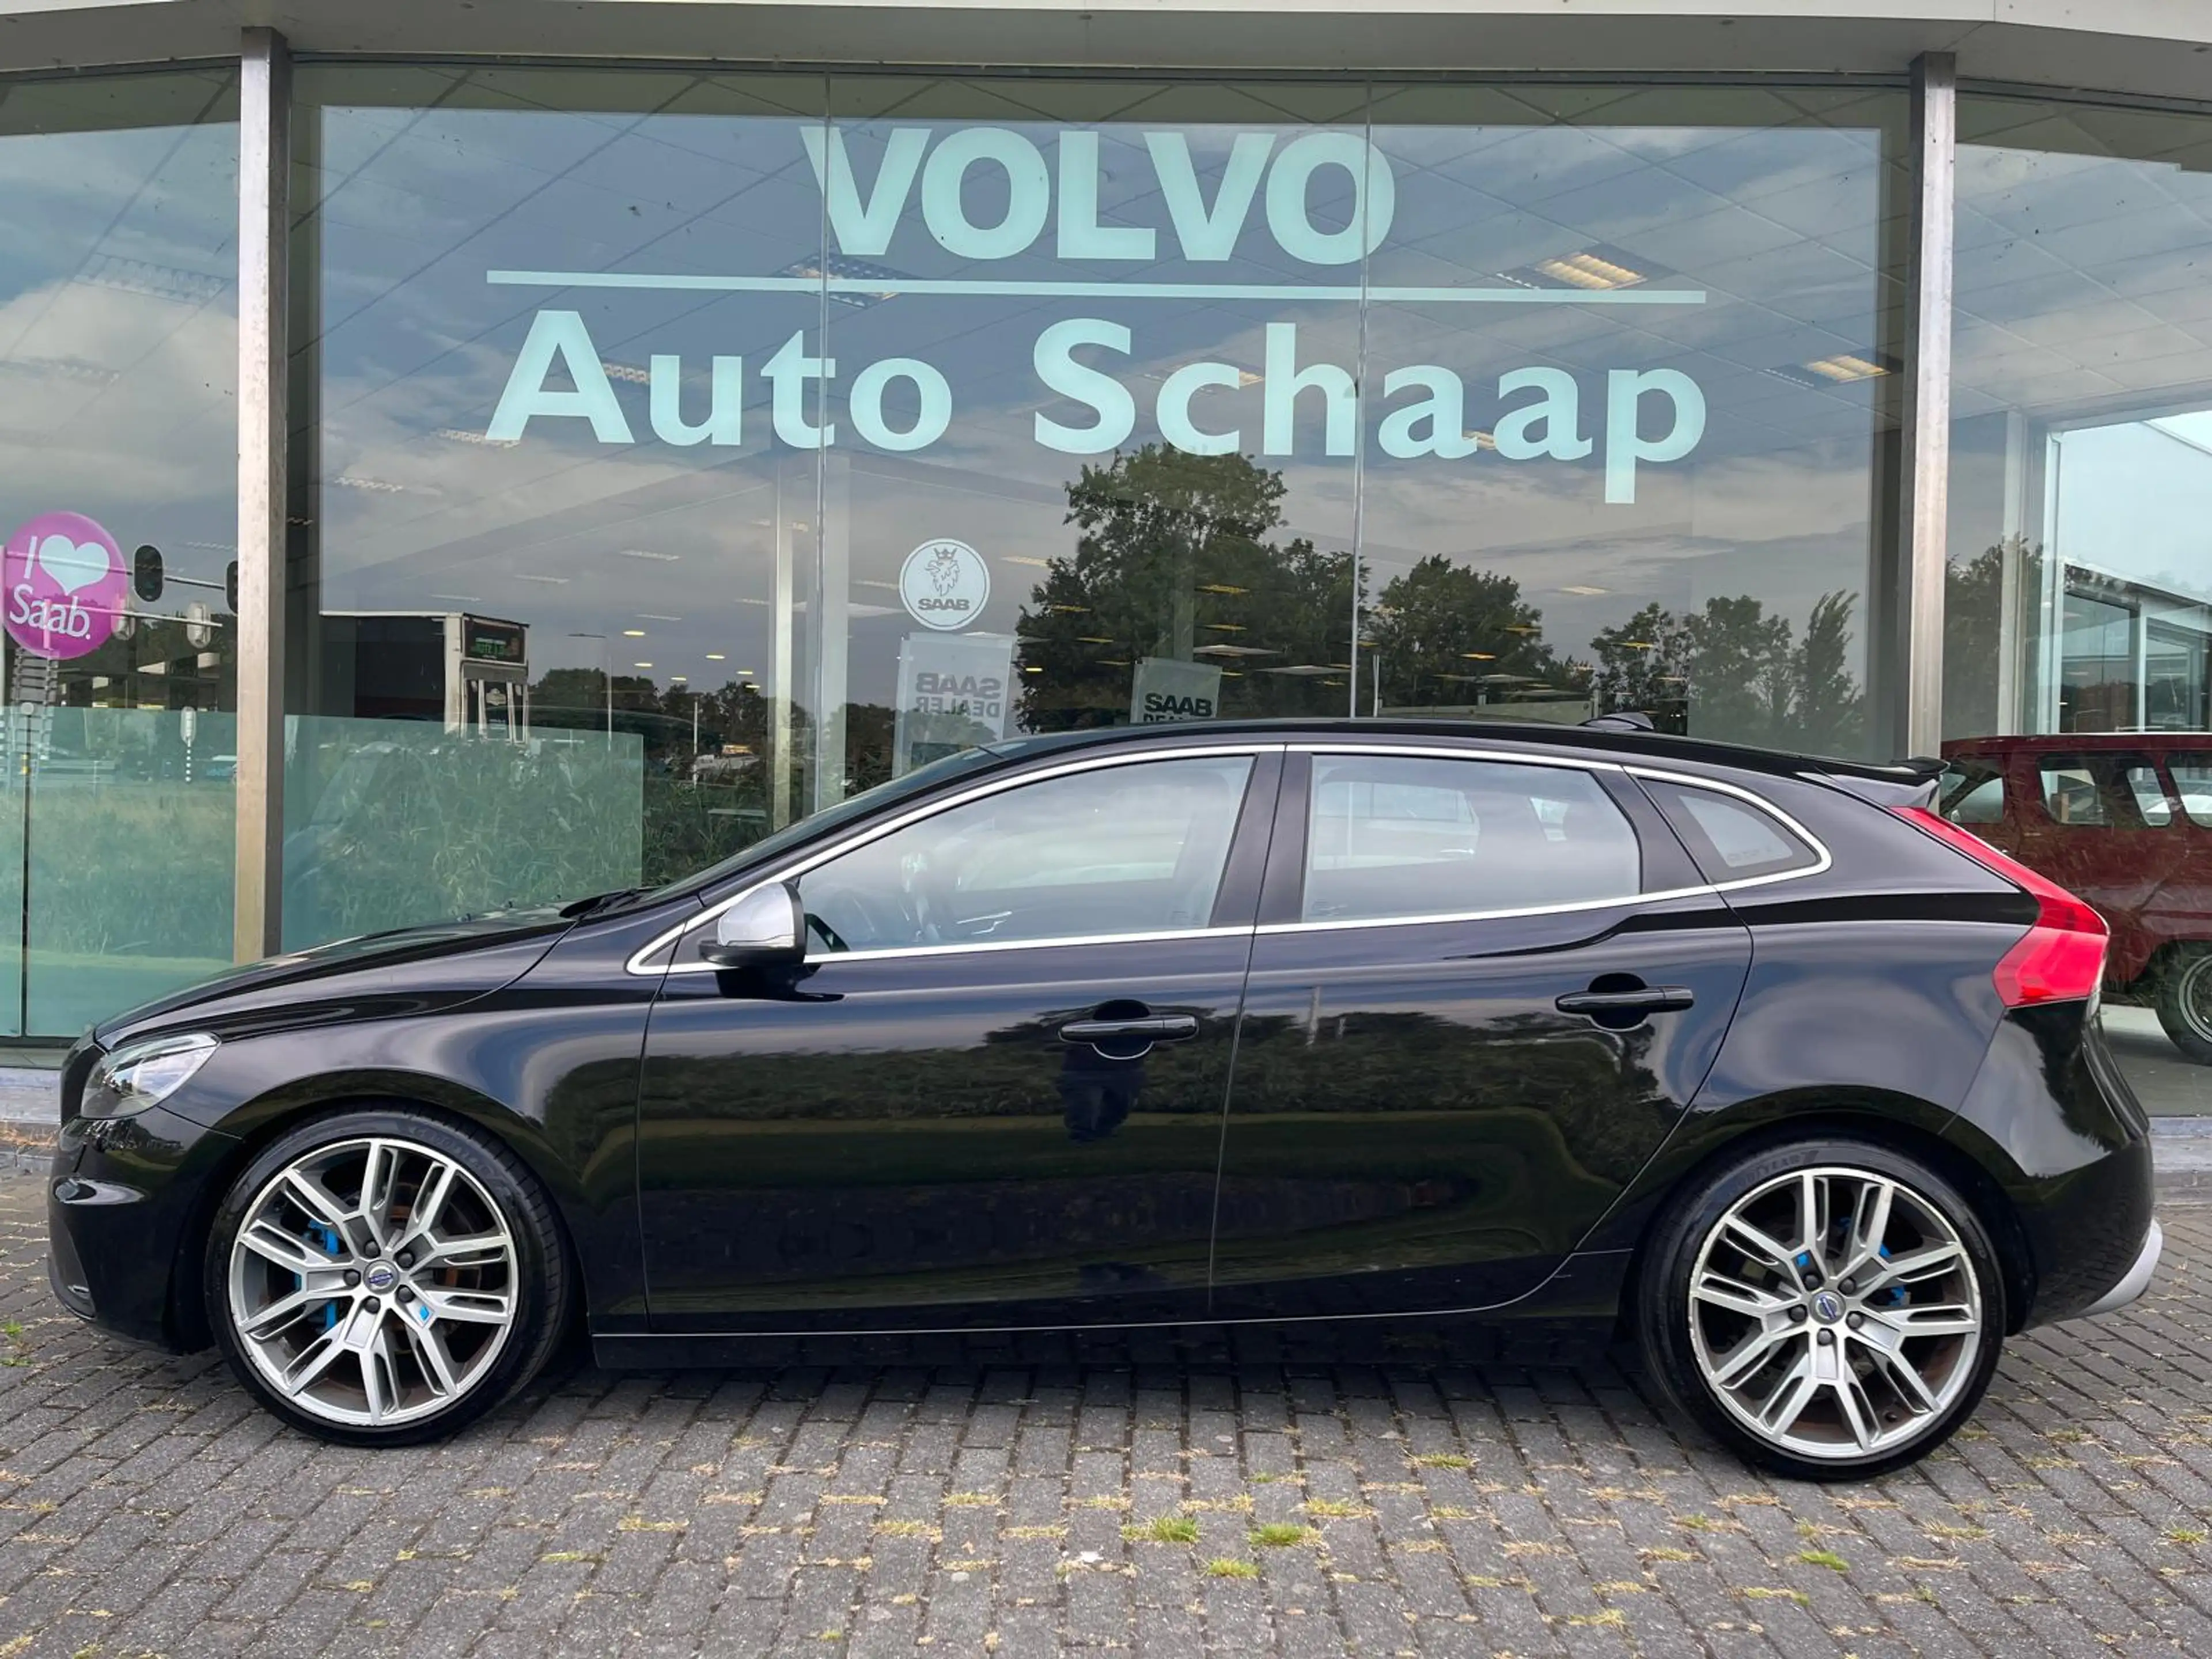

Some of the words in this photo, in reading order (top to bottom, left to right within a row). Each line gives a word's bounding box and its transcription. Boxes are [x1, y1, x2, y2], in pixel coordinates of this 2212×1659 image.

[800, 126, 1395, 265] VOLVO
[485, 309, 953, 452] Auto
[1033, 317, 1707, 504] Schaap
[24, 536, 37, 579] I
[9, 583, 91, 639] Saab.
[918, 598, 971, 611] SAAB
[1144, 692, 1213, 717] SAAB
